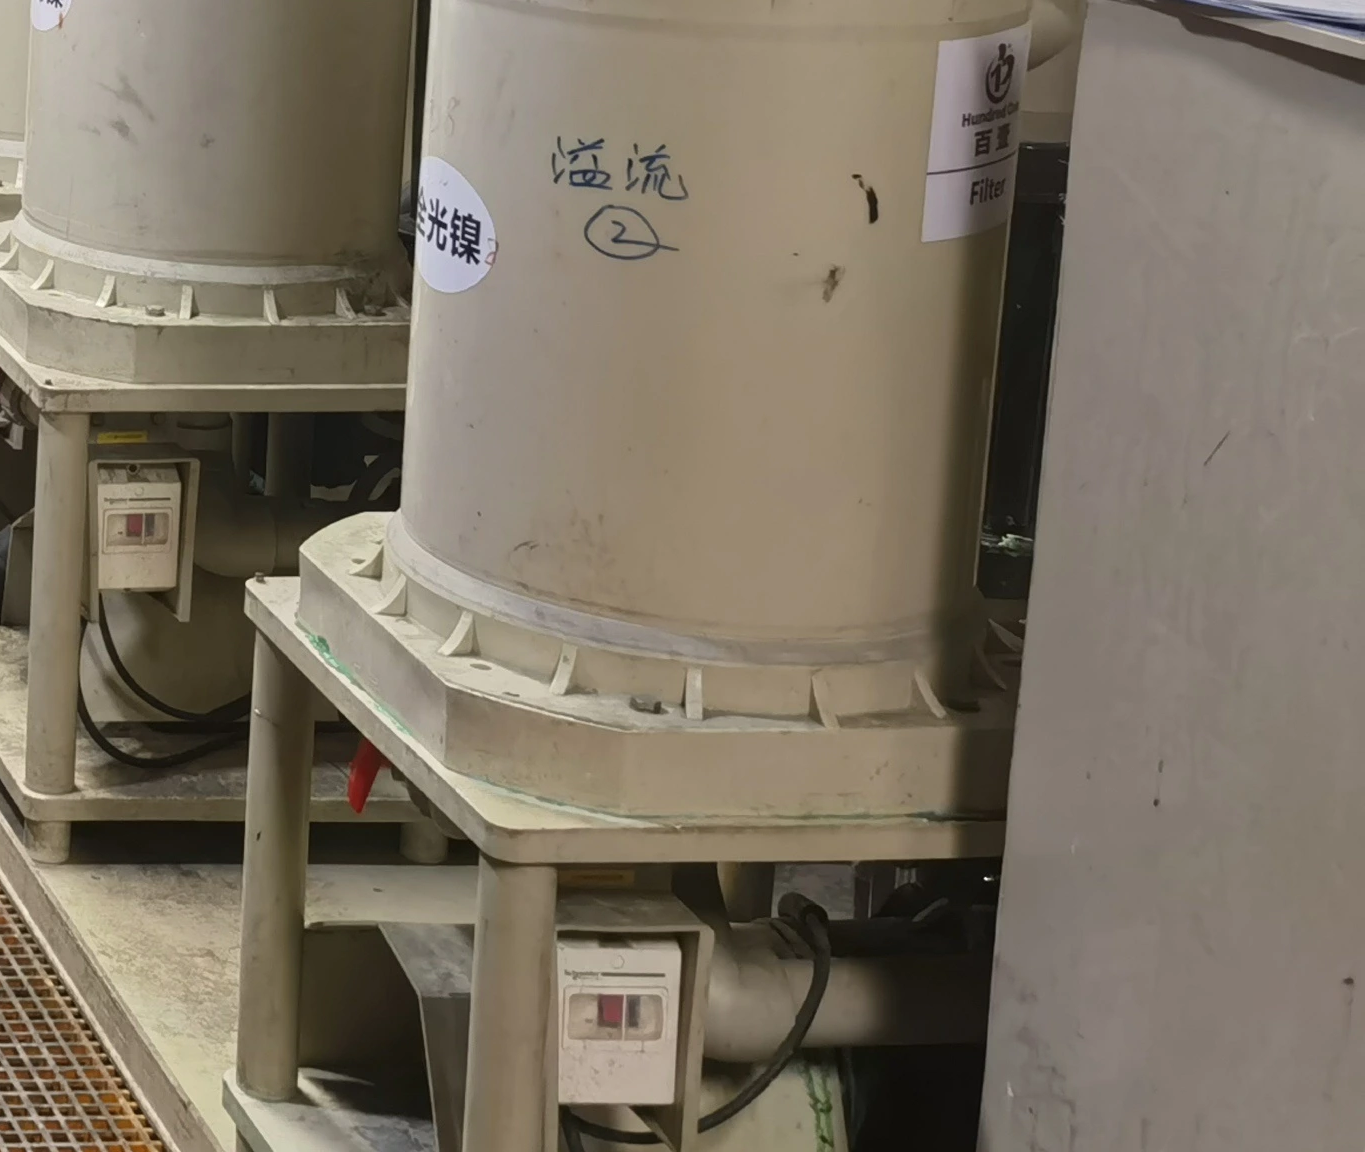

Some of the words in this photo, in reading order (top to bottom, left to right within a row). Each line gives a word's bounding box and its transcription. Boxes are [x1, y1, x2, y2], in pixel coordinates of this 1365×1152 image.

[961, 105, 1007, 127] Hundred
[974, 123, 1011, 157] 百壹
[551, 135, 689, 201] 溢流
[969, 178, 1007, 205] Filter
